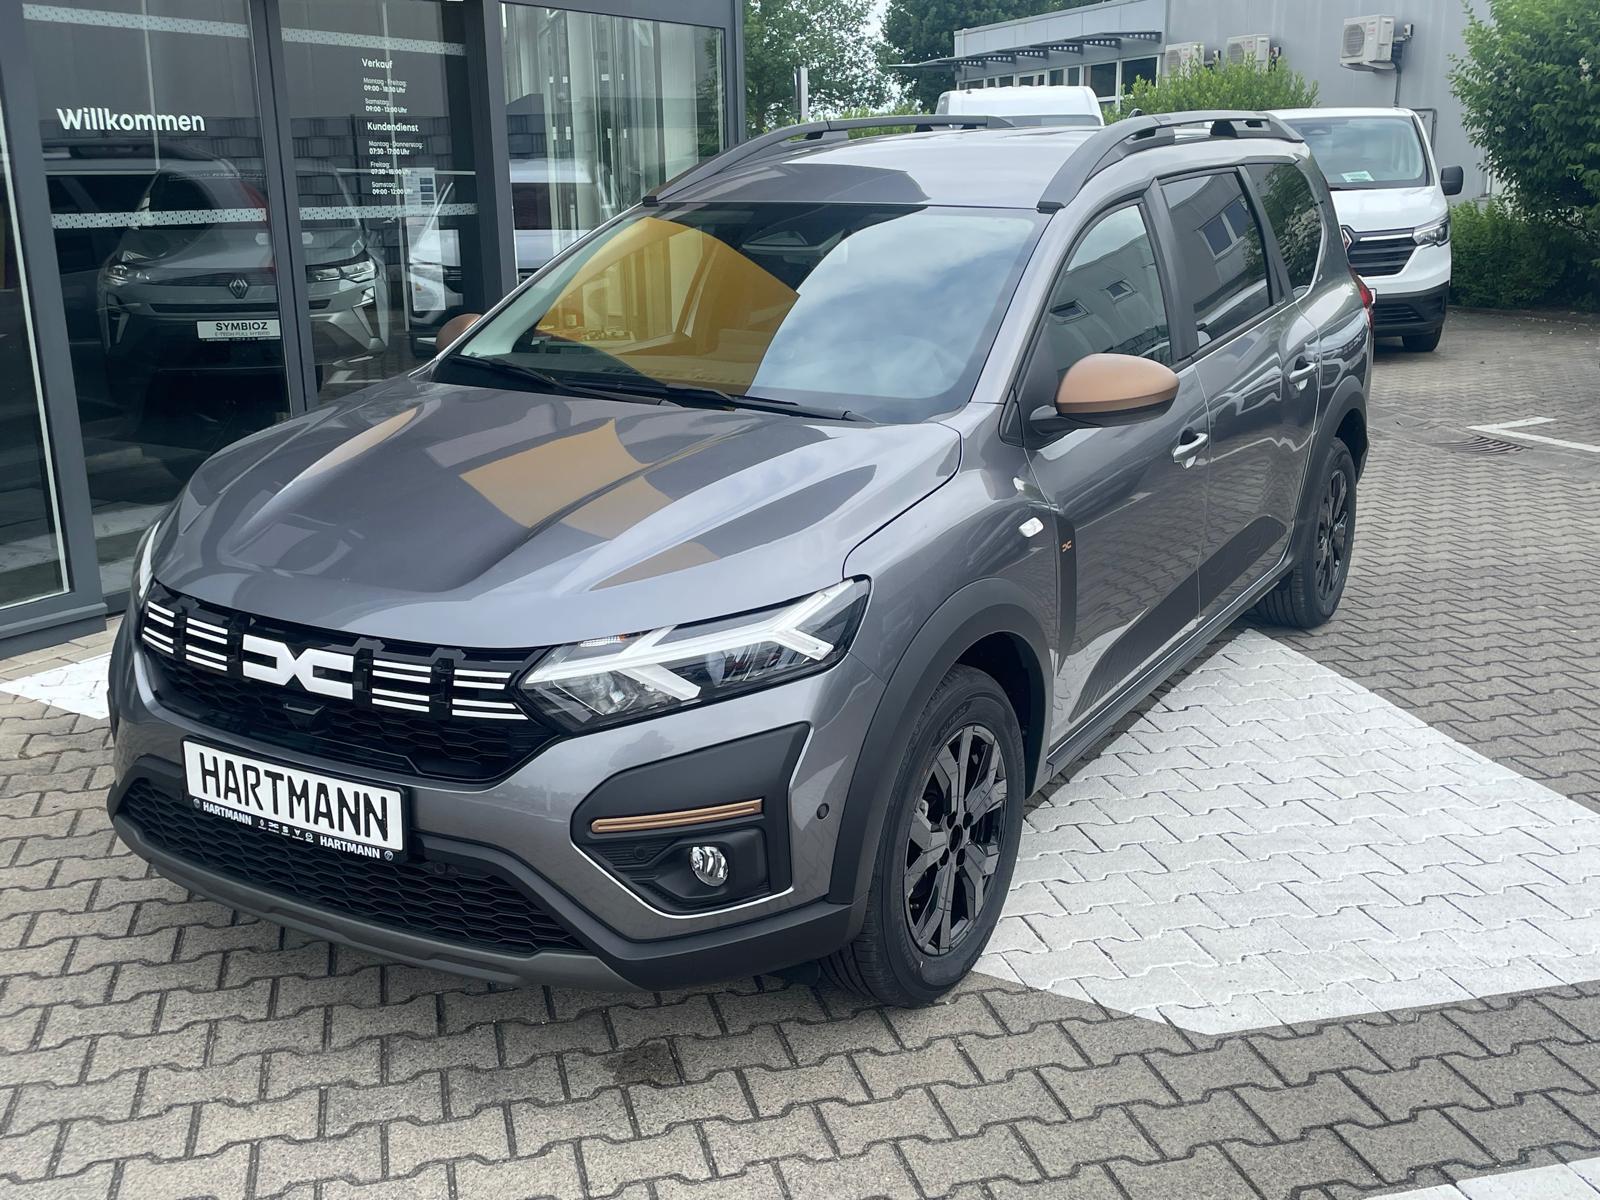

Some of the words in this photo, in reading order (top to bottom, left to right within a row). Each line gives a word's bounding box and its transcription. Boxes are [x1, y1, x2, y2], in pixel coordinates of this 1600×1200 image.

[361, 58, 393, 69] Verkauf
[56, 107, 205, 132] Willkommen
[367, 122, 419, 132] Kundendienst
[368, 140, 390, 148] Montag
[215, 322, 268, 331] SYMBIOZ
[199, 752, 388, 842] HARTMANN
[202, 801, 252, 826] HARTMANN
[320, 836, 380, 859] HARTMANN
